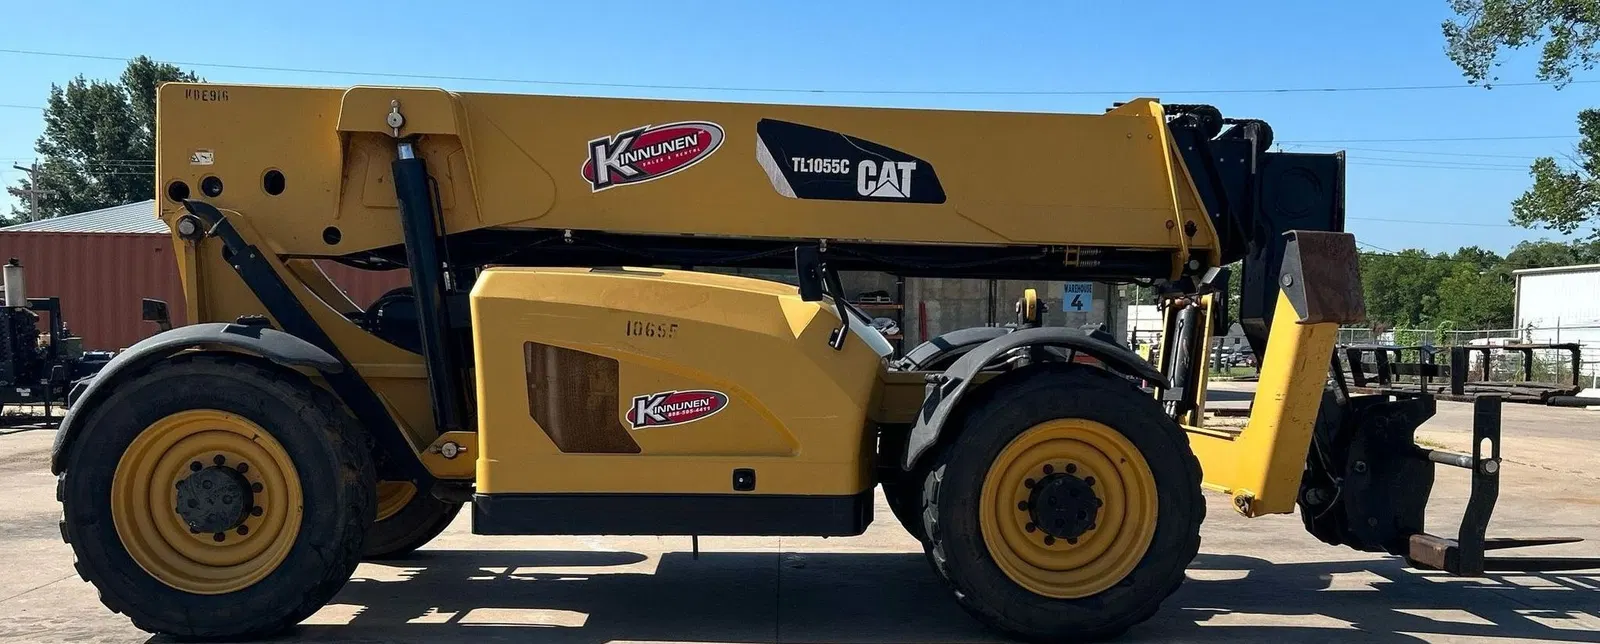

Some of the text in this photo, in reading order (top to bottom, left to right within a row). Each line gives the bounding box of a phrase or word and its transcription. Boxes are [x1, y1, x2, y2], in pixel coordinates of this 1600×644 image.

[594, 134, 698, 185] KINNUNEN
[791, 157, 850, 174] TL1055C
[857, 159, 917, 198] CAT
[1063, 283, 1092, 294] WAREHOUSE
[1070, 293, 1084, 311] 4
[635, 395, 710, 425] KINNUNEN
